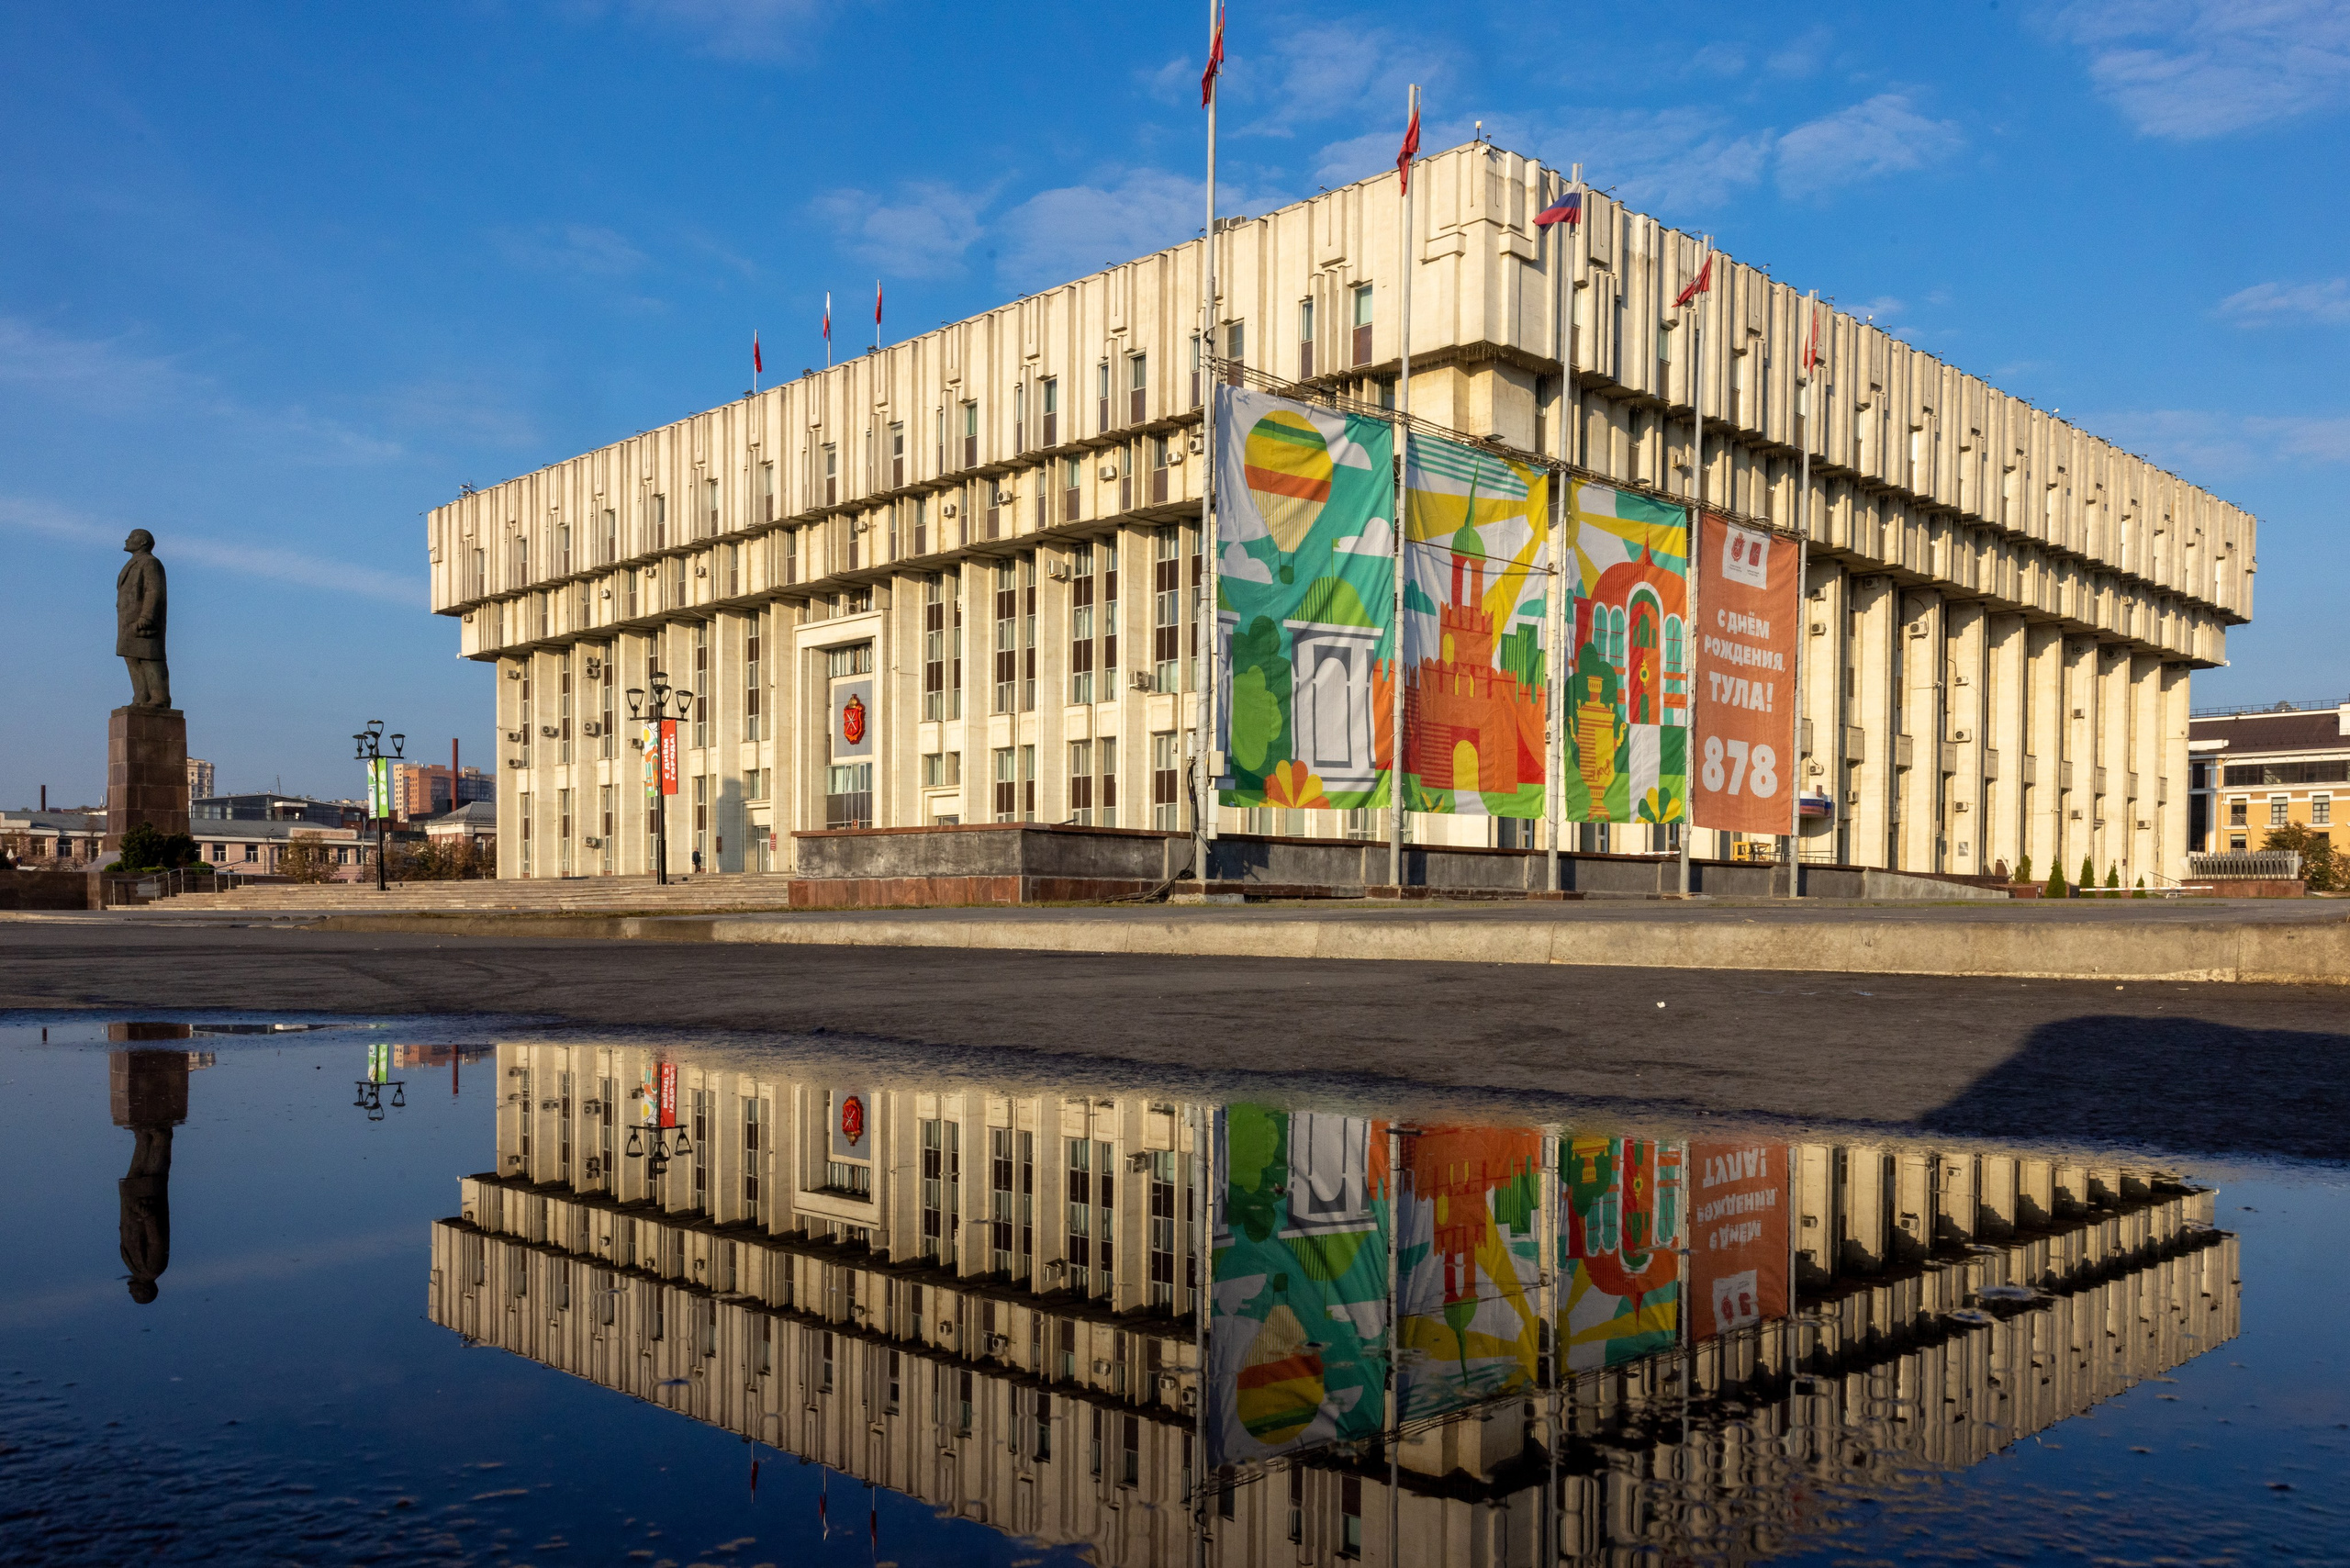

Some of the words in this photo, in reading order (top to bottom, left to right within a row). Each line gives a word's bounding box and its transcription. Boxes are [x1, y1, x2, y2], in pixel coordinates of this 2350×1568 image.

[1717, 609, 1726, 628] С
[1727, 611, 1771, 640] ДНЁМ
[1704, 634, 1786, 673] РОЖДЕНИЯ,
[1709, 670, 1774, 712] ТУЛА!
[1702, 735, 1778, 799] 878
